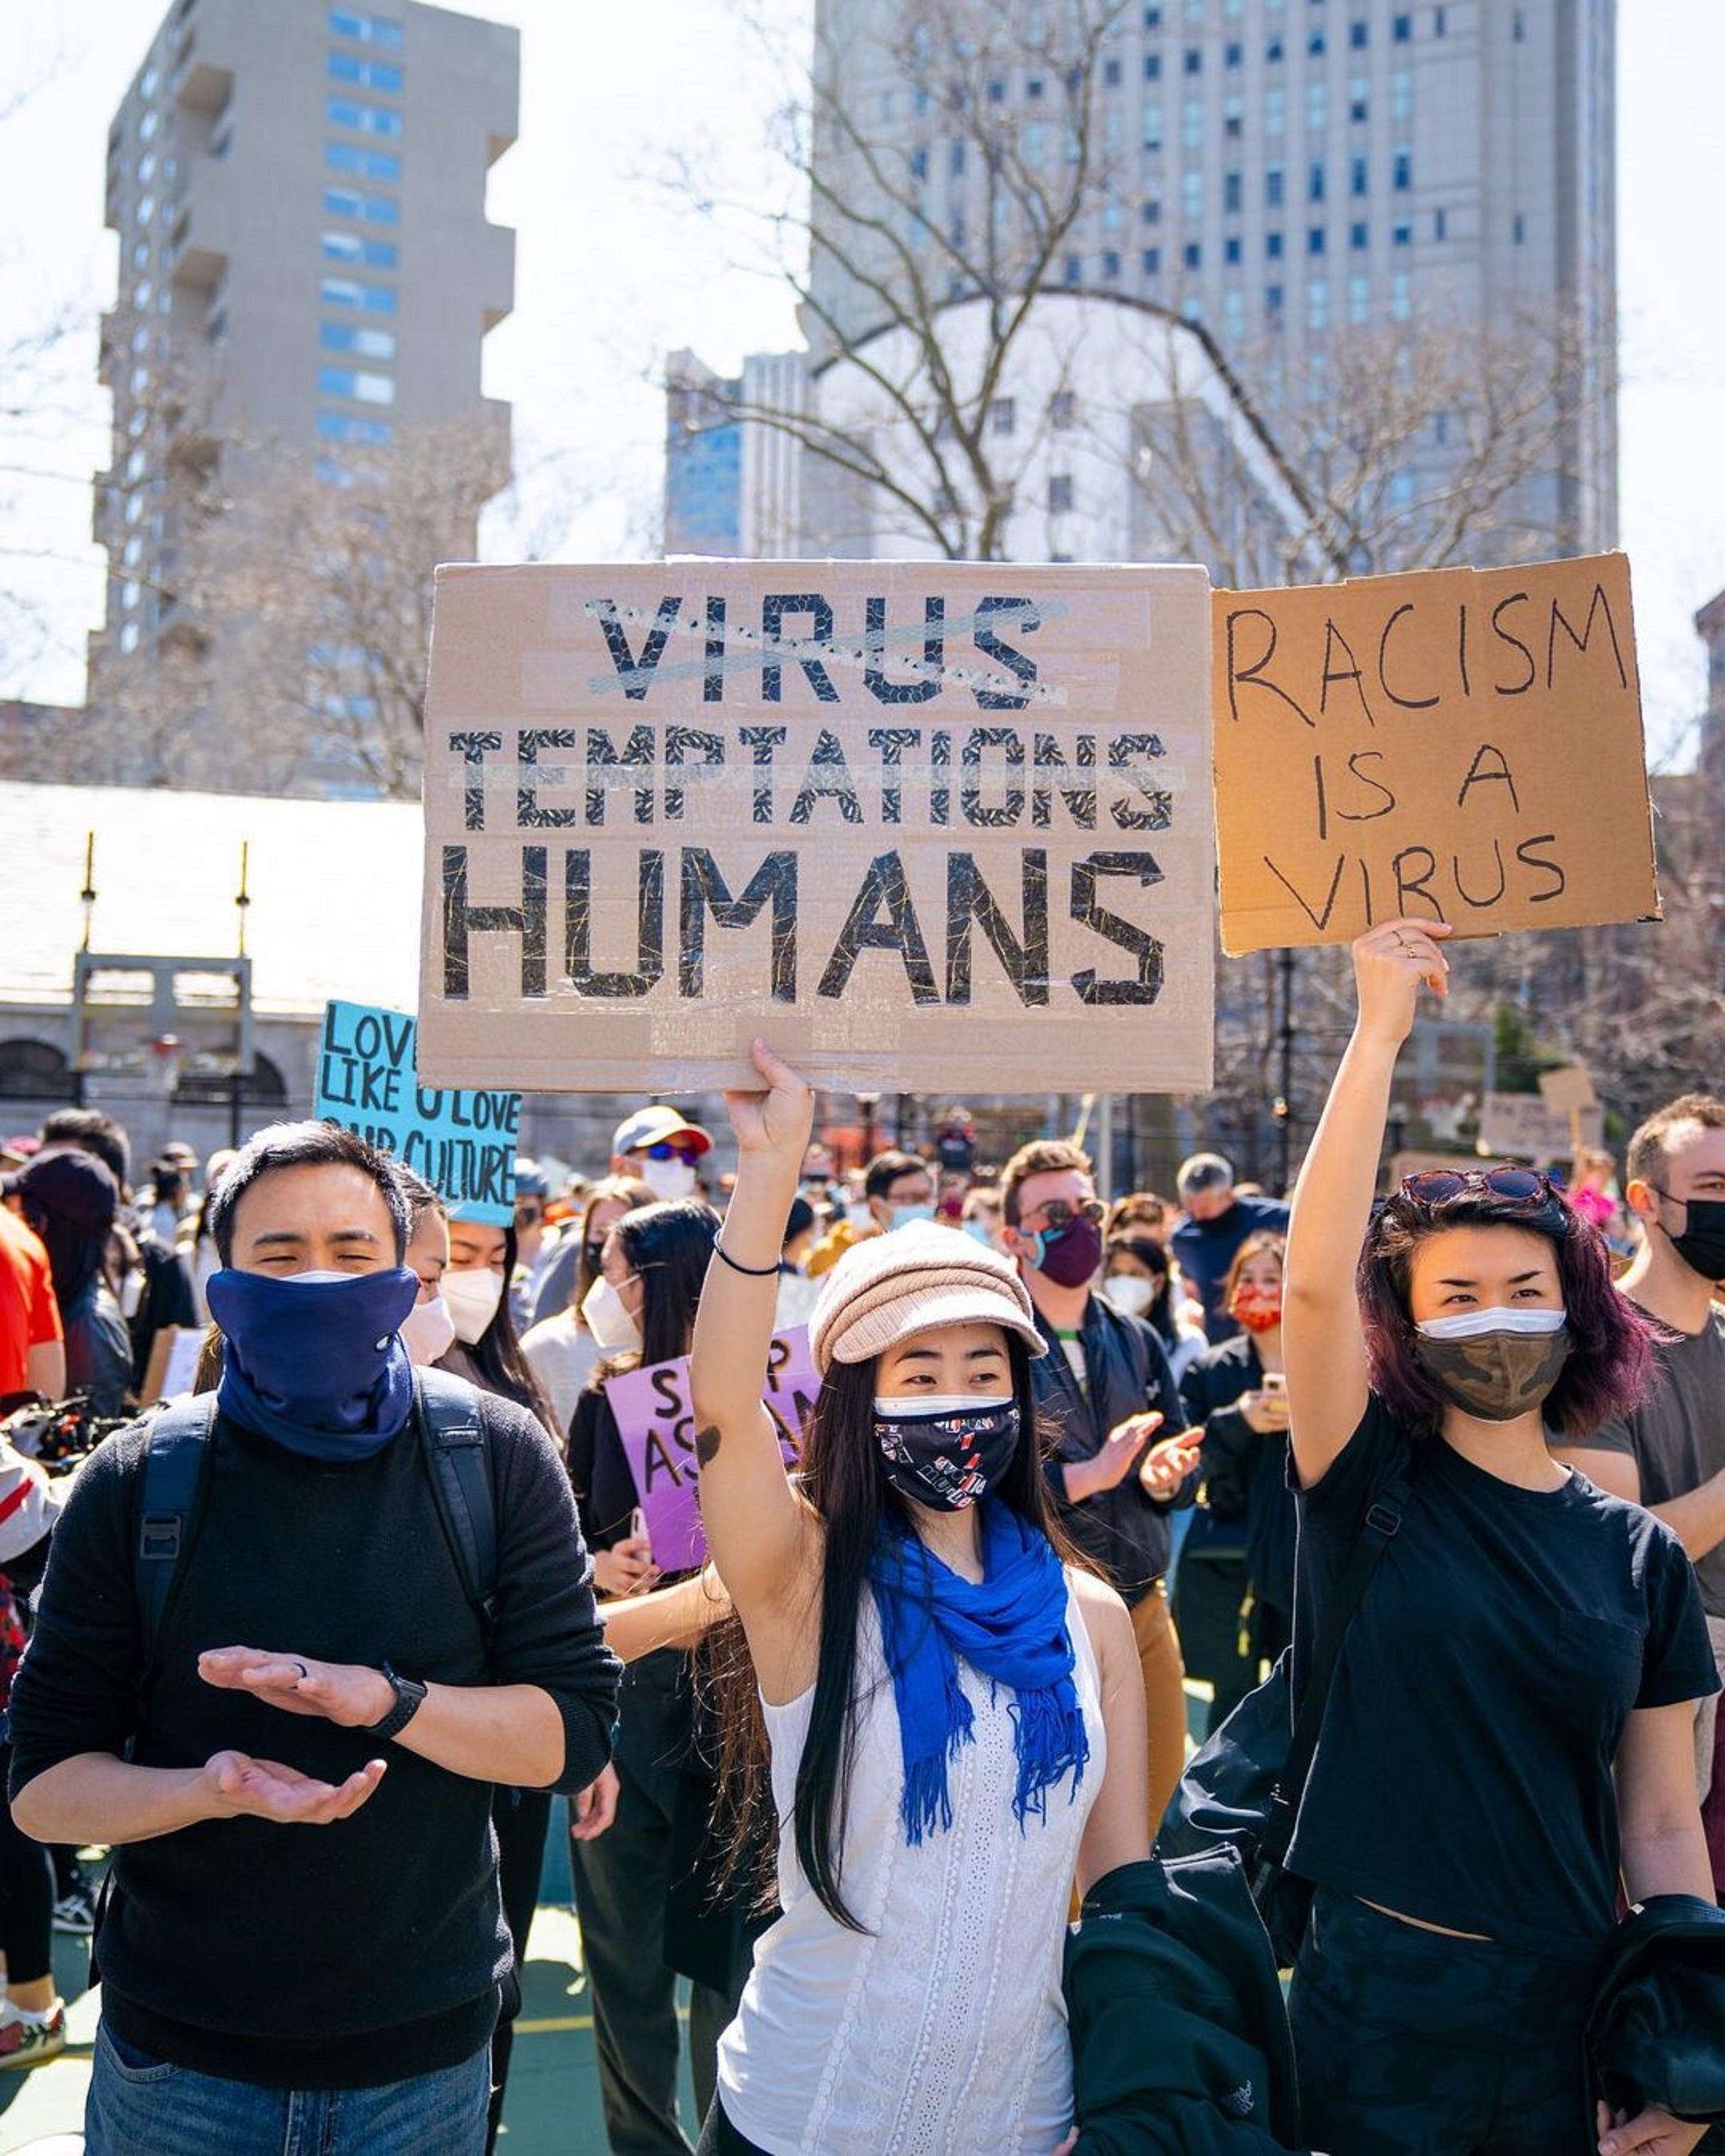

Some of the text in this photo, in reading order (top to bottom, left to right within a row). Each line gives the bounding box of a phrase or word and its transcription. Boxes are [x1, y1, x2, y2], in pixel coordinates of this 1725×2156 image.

[595, 594, 1040, 710] VIRUS
[1227, 584, 1628, 727] RACISM
[449, 725, 1172, 831] TEMPTATIONS
[1315, 744, 1520, 839] IS A
[442, 846, 1164, 1008] HUMANS
[1263, 835, 1565, 930] VIRUS
[325, 1004, 418, 1072] LOV
[321, 1054, 402, 1112] LIKE
[451, 1090, 522, 1134] LOVE
[403, 1130, 518, 1207] CULTURE
[652, 1339, 791, 1419] SP
